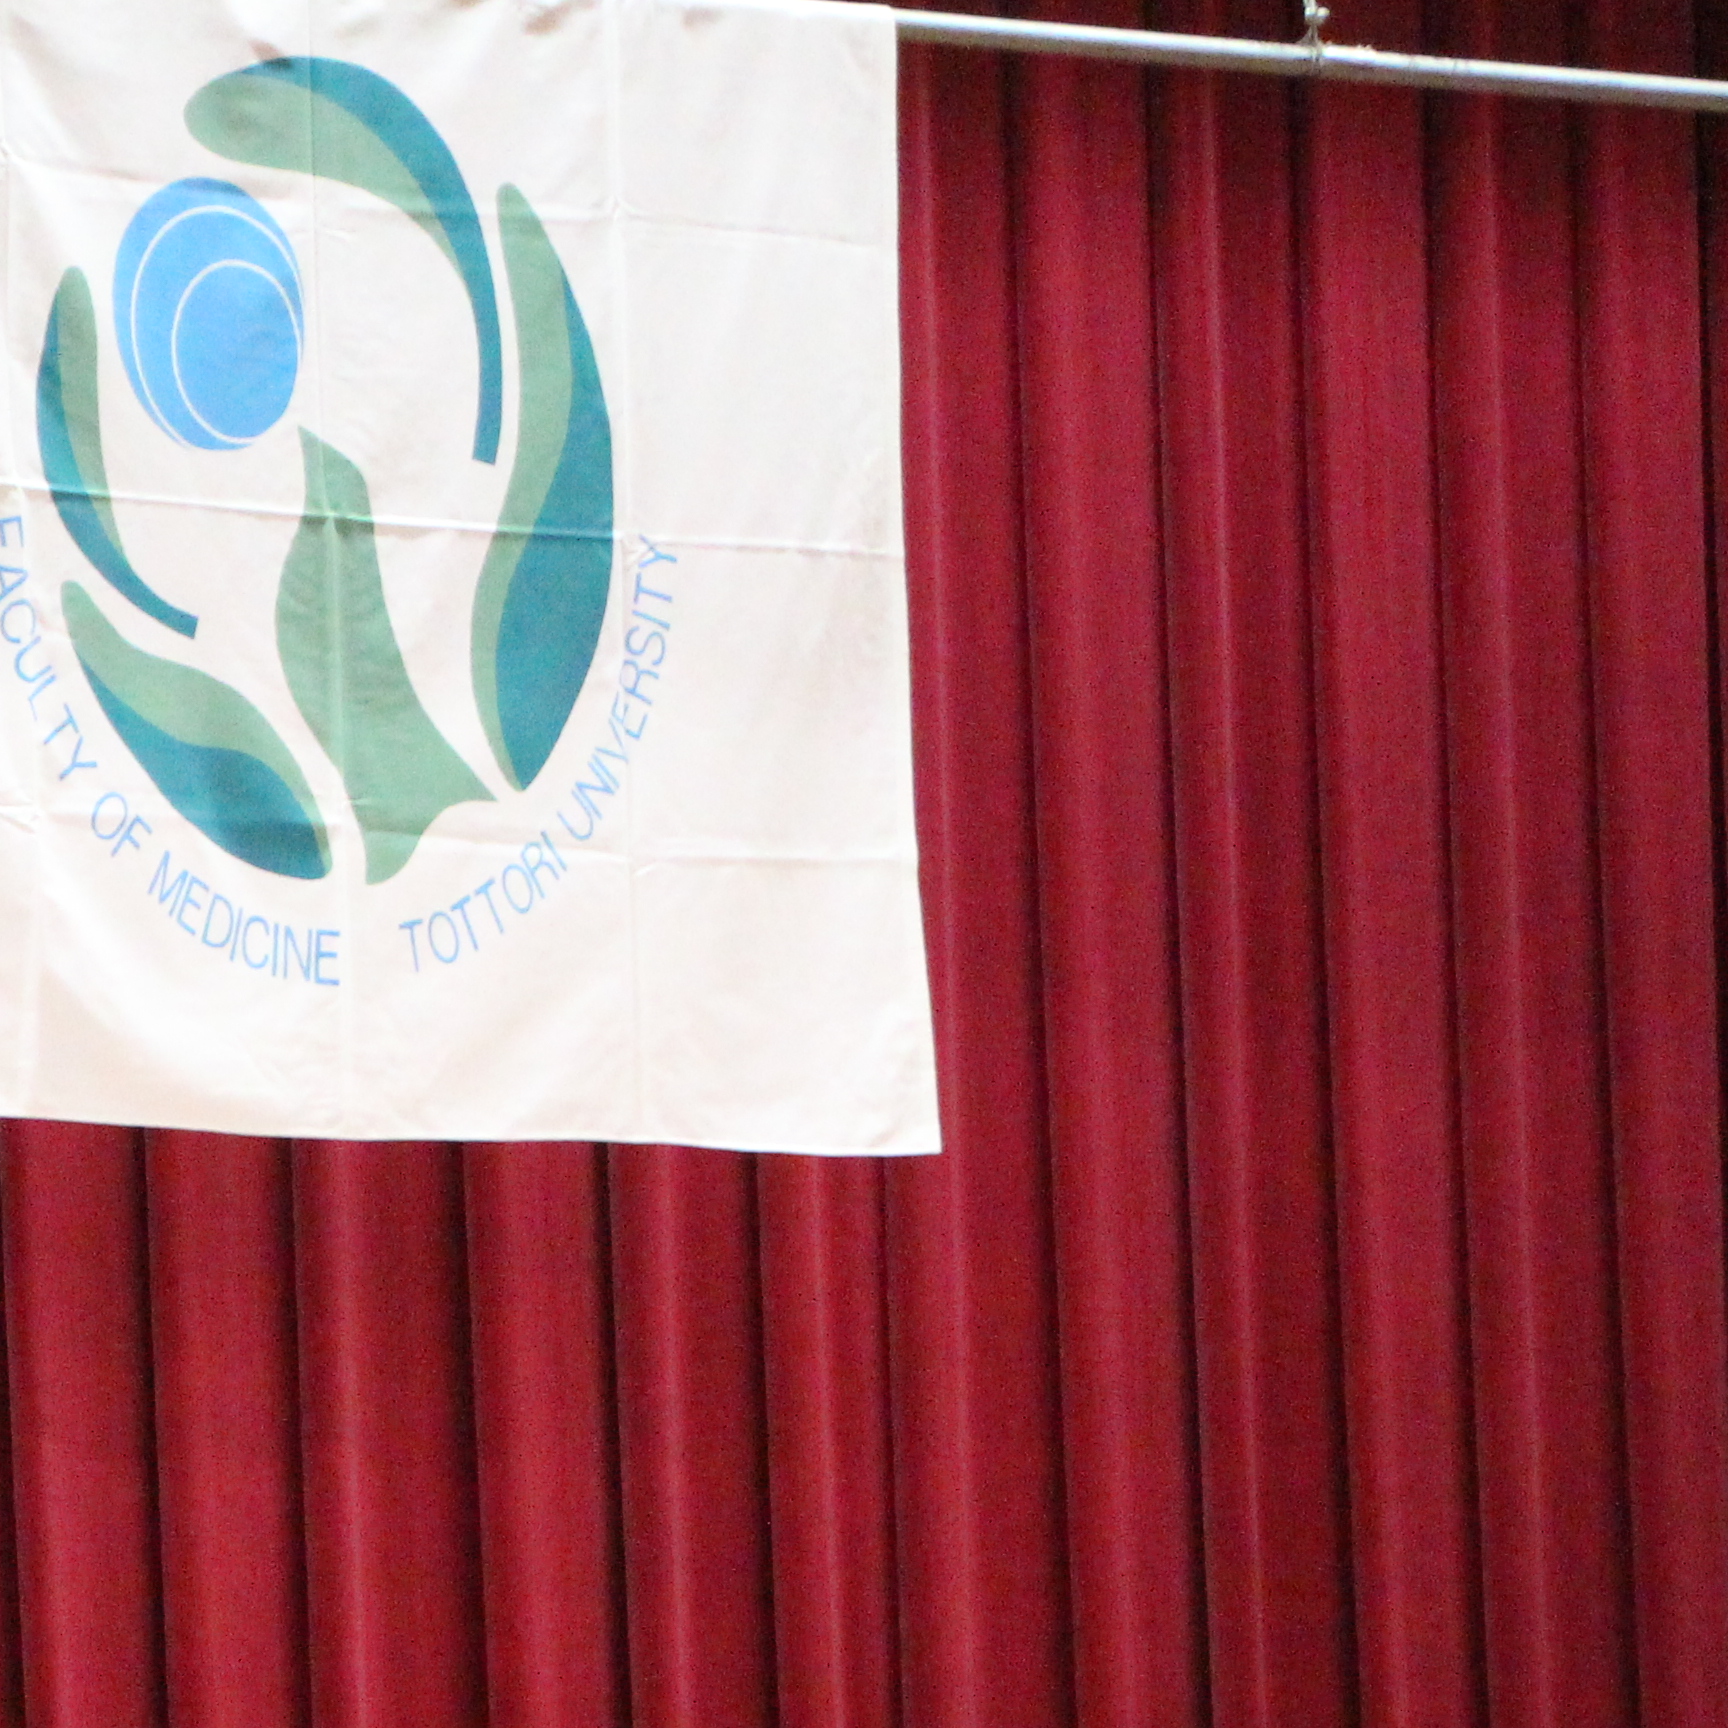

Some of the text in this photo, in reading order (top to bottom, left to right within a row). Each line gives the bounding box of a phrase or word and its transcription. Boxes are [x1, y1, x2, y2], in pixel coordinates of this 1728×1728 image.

[90, 792, 153, 858] OF
[147, 850, 341, 987] MEDICINE
[398, 533, 679, 974] TOTTORI UNIVERSITY
